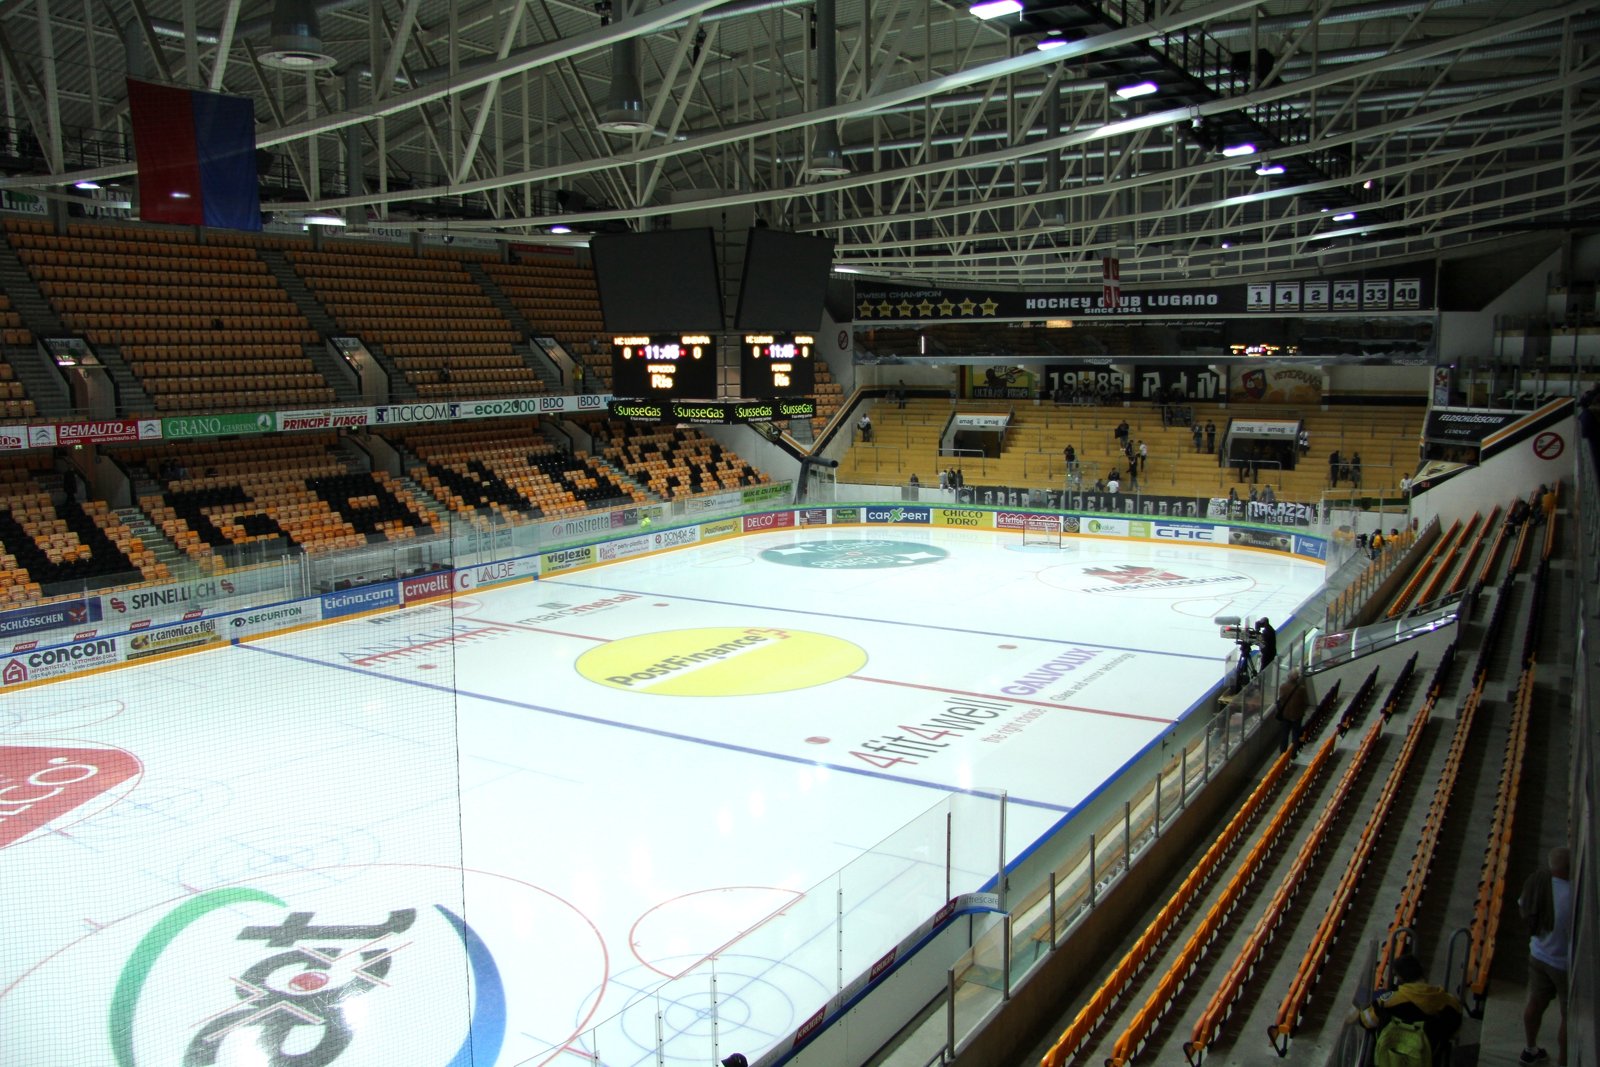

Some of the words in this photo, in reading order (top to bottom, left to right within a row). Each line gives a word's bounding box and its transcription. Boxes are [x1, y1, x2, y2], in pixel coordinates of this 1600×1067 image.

[32, 204, 45, 213] SA
[889, 290, 942, 298] CHAMPION
[1255, 291, 1263, 303] 1
[1282, 290, 1293, 303] 4
[1311, 290, 1321, 301] 2
[1335, 289, 1355, 301] 44
[1365, 288, 1387, 301] 33
[1396, 287, 1418, 300] 40
[1097, 296, 1141, 307] CUB
[1147, 294, 1218, 306] LUGANO
[623, 347, 632, 359] 0
[693, 346, 702, 359] 0
[753, 346, 760, 358] 0
[802, 346, 809, 358] 0
[652, 374, 673, 388] Ris
[774, 373, 790, 387] Ris
[542, 397, 564, 409] BDO
[580, 395, 600, 406] BDO
[390, 405, 447, 422] TICICOM
[474, 399, 536, 416] eco2000
[168, 417, 221, 436] GRANO
[283, 417, 330, 430] PRINCIPE
[332, 415, 368, 427] VIAGGI
[60, 422, 123, 437] BEMAUTO
[126, 426, 136, 434] SA
[1236, 425, 1254, 434] amag
[942, 509, 983, 519] CHICCO
[565, 515, 609, 536] mistretta
[664, 530, 687, 543] DONADA
[1155, 528, 1213, 541] CHC
[547, 548, 591, 563] viglezio
[477, 561, 516, 582] LAUBE
[405, 575, 449, 597] crivelli
[324, 587, 394, 610] ticino.com
[0, 612, 64, 632] SCHLÖSSCHEN
[247, 607, 302, 624] SECURITON
[150, 625, 193, 642] r.canonica
[200, 618, 216, 633] figli
[605, 632, 768, 687] PostFinance
[1000, 647, 1104, 696] GALVOLUX
